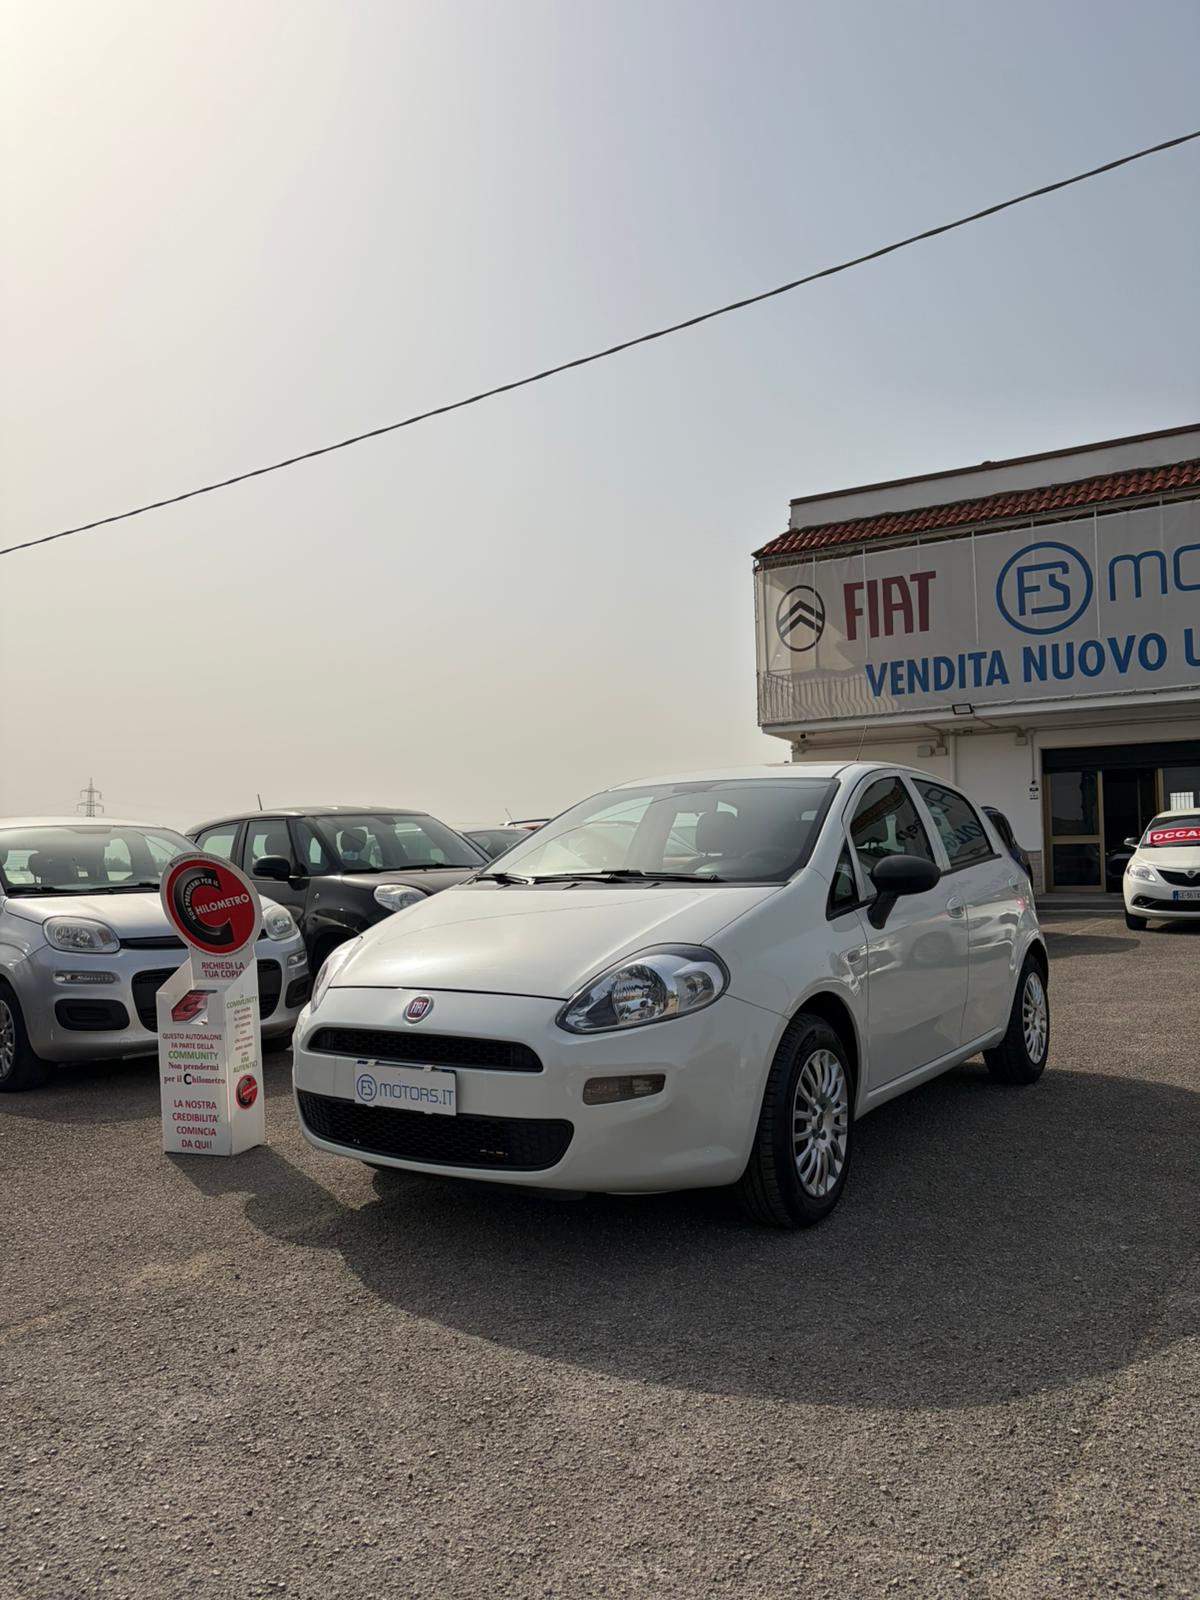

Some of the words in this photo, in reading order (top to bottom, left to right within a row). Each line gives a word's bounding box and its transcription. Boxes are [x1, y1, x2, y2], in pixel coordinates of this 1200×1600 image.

[843, 570, 937, 641] FIAT
[865, 649, 1010, 698] VENDITA
[1023, 632, 1168, 683] NUOVO
[1152, 830, 1200, 841] OCCA
[201, 961, 234, 970] RICHIEDI
[235, 962, 245, 970] LA
[204, 970, 219, 978] TUA
[409, 1001, 428, 1014] FIAT
[162, 1032, 184, 1040] QUESTO
[185, 1033, 222, 1041] AUTOSALONE
[168, 1051, 219, 1060] COMMUNITY
[168, 1061, 182, 1070] Non
[183, 1062, 219, 1071] prendermi
[163, 1075, 175, 1084] per
[176, 1075, 182, 1083] il
[183, 1073, 226, 1085] Chilometro
[379, 1082, 454, 1106] MOTORS.IT
[173, 1099, 184, 1108] LA
[185, 1100, 217, 1110] NOSTRA
[176, 1126, 217, 1136] COMINCIA
[181, 1139, 193, 1148] DA
[194, 1139, 212, 1150] QUI!
